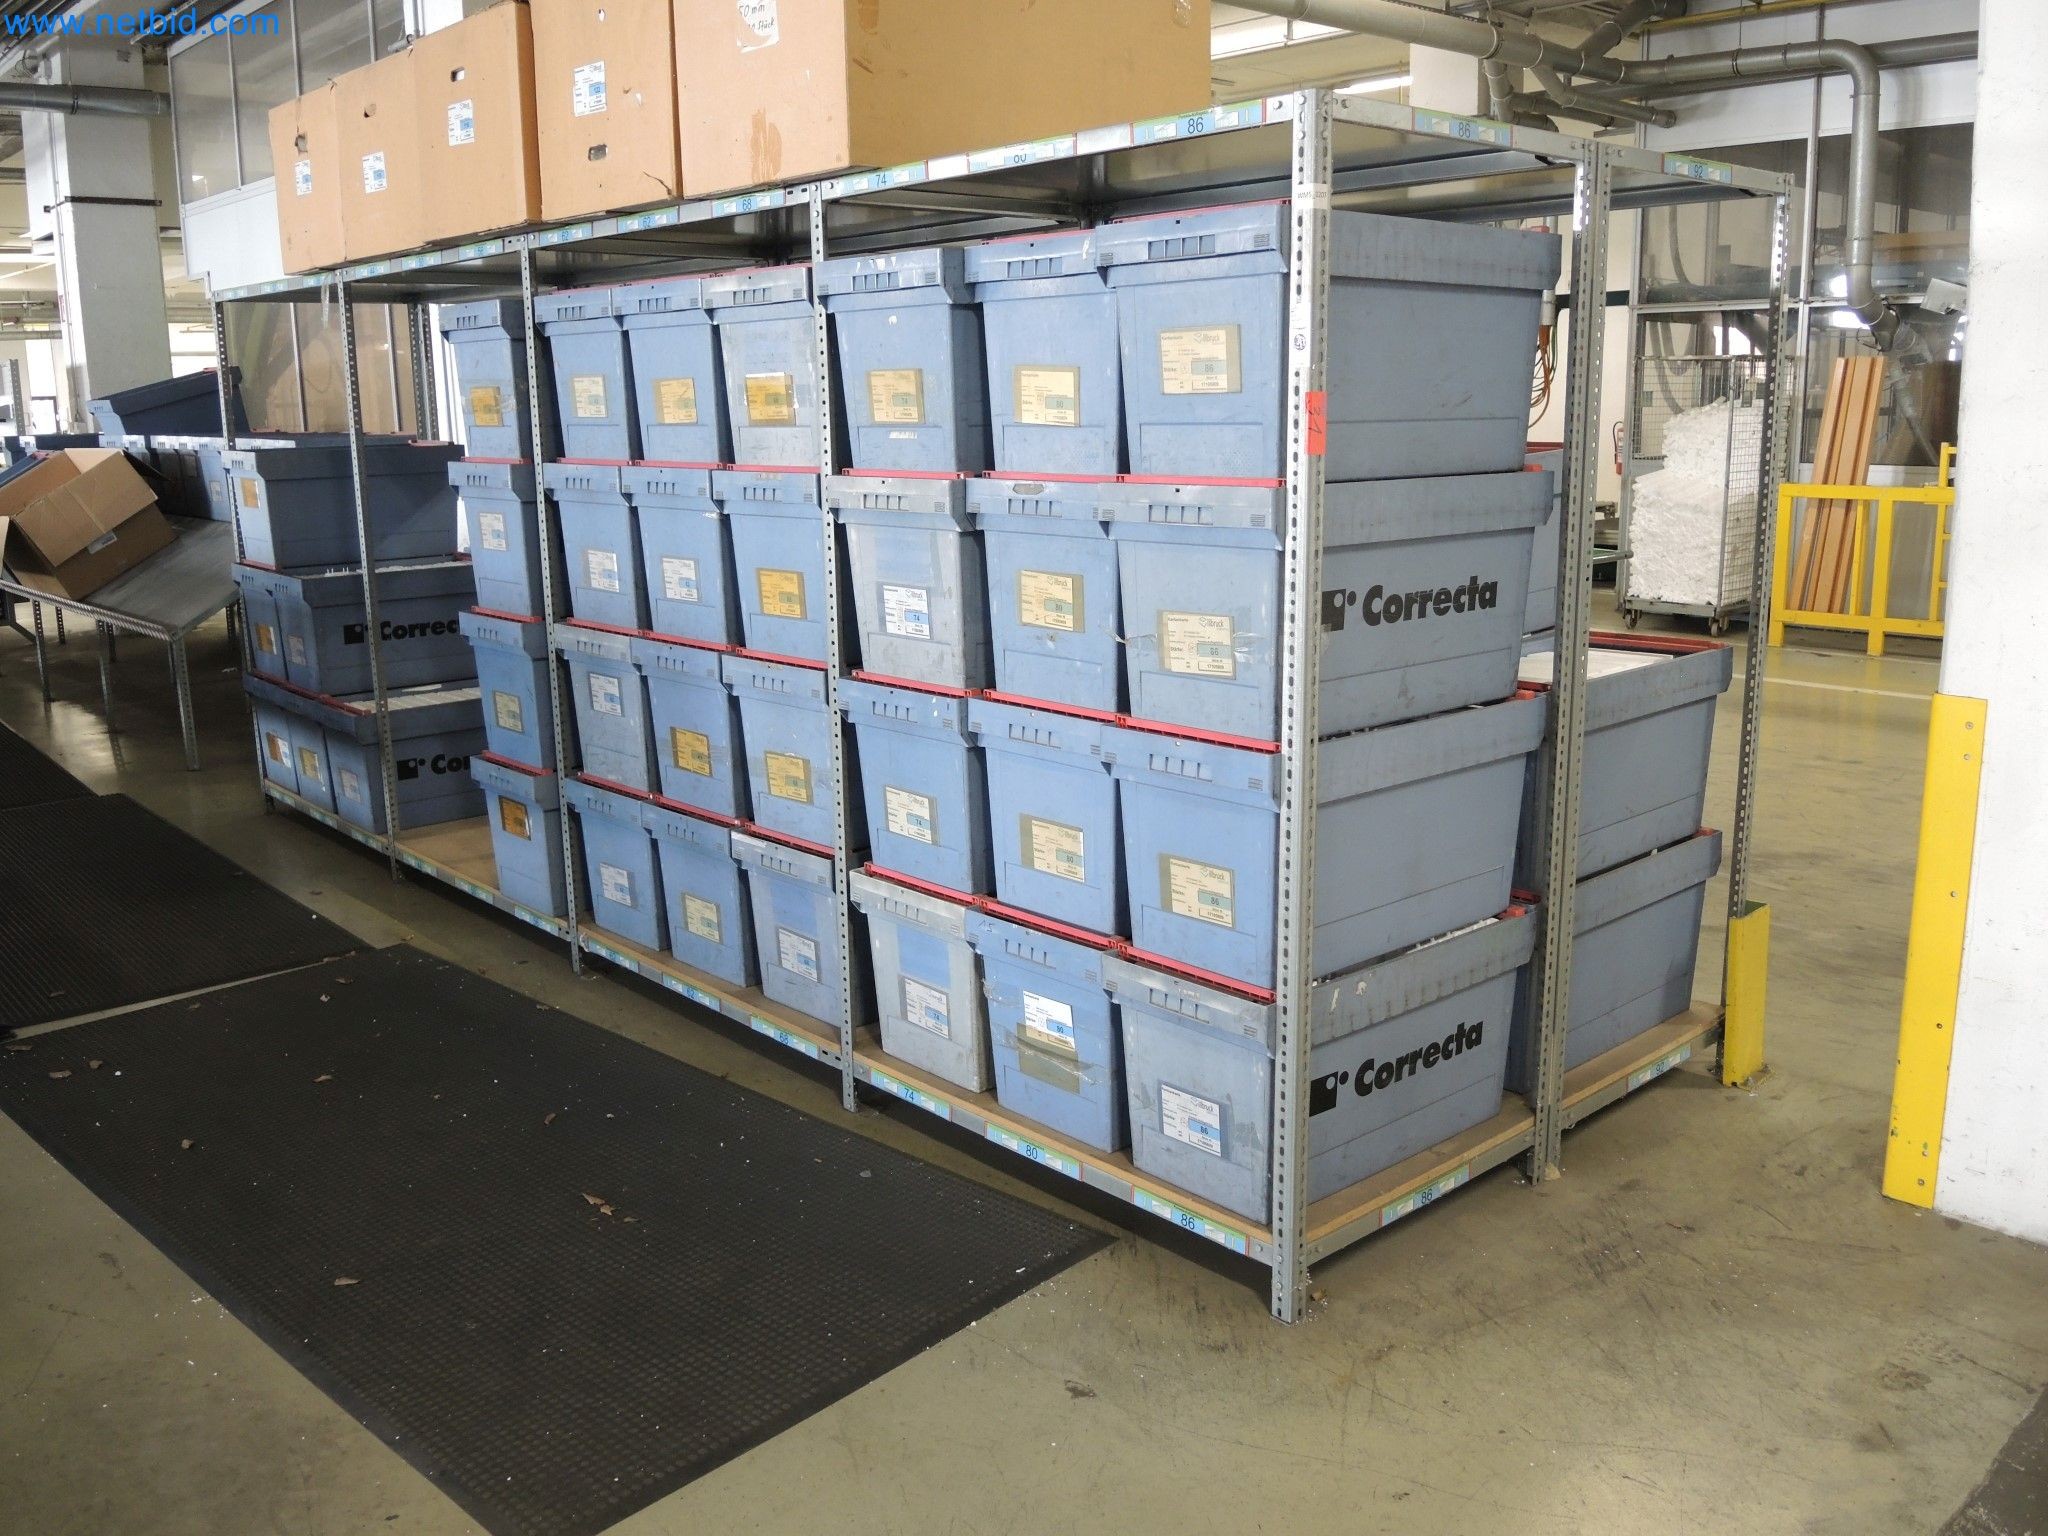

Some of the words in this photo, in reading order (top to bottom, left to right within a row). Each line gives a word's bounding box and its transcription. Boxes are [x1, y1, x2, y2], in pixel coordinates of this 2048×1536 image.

[1187, 116, 1204, 134] 86
[1458, 121, 1471, 139] 86
[875, 171, 887, 188] 74
[1694, 164, 1703, 178] 92
[1362, 575, 1499, 627] Correcta
[379, 619, 460, 641] Correc
[1354, 1020, 1484, 1097] Correcta
[903, 1087, 915, 1102] 74
[1025, 1144, 1038, 1160] 80
[1421, 1188, 1433, 1205] 86
[1180, 1213, 1195, 1230] 86
